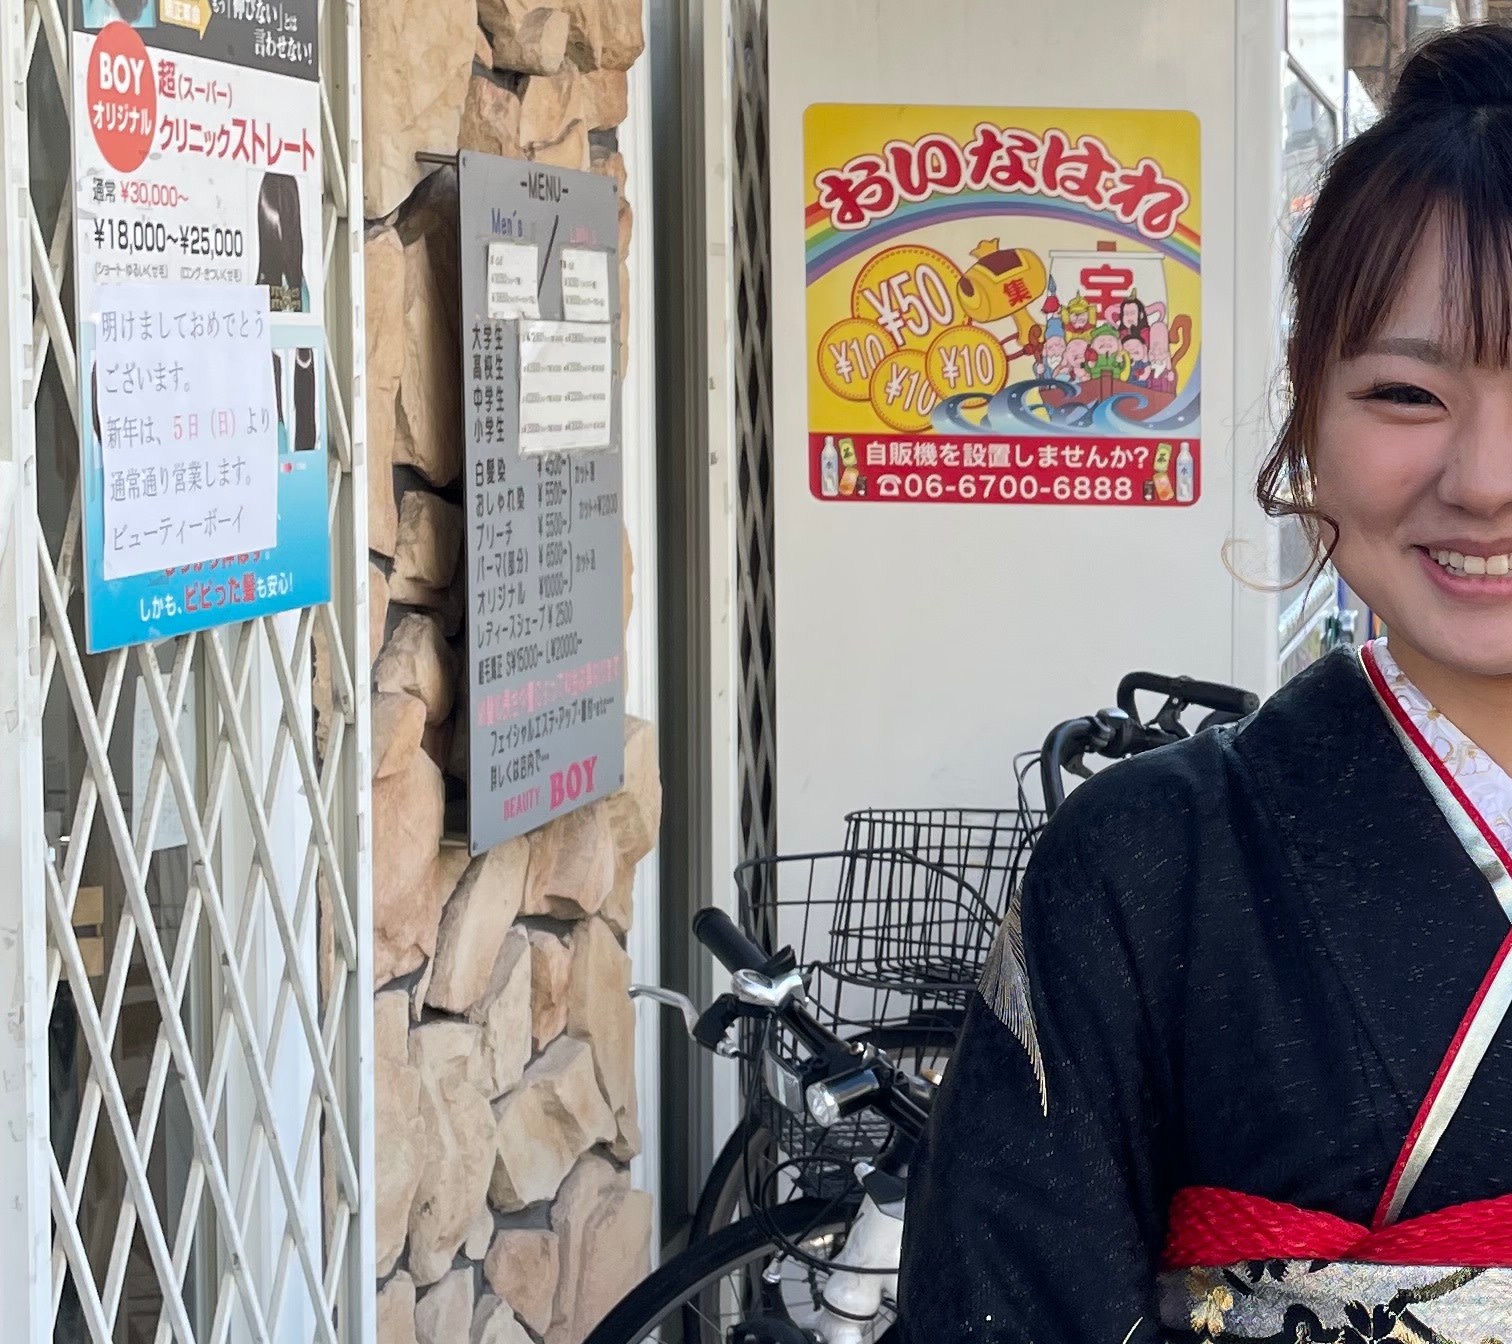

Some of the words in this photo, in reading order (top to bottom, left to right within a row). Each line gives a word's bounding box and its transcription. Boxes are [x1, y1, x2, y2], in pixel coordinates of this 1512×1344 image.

[98, 50, 145, 97] BOY
[92, 99, 152, 137] オリジナル
[159, 113, 314, 171] クリニックストレート
[819, 129, 1187, 235] おいなはれ
[862, 264, 952, 347] ¥50
[1002, 278, 1032, 307] 集
[100, 309, 264, 341] 明けましておめでとう
[472, 322, 503, 351] 大学生
[105, 360, 191, 395] ございます。
[473, 352, 504, 381] 高校生
[942, 346, 994, 389] ¥10
[473, 384, 504, 413] 中学生
[474, 415, 504, 444] 小学生
[866, 440, 1149, 470] 自販機を設置しませんか?
[109, 456, 251, 502] 通常通り営業します。
[905, 475, 1132, 501] 06-6700-6888
[476, 485, 525, 518] おしゃれ染
[112, 504, 245, 553] ビューティーボーイ
[477, 580, 526, 615] オリジナル
[549, 754, 598, 812] BOY
